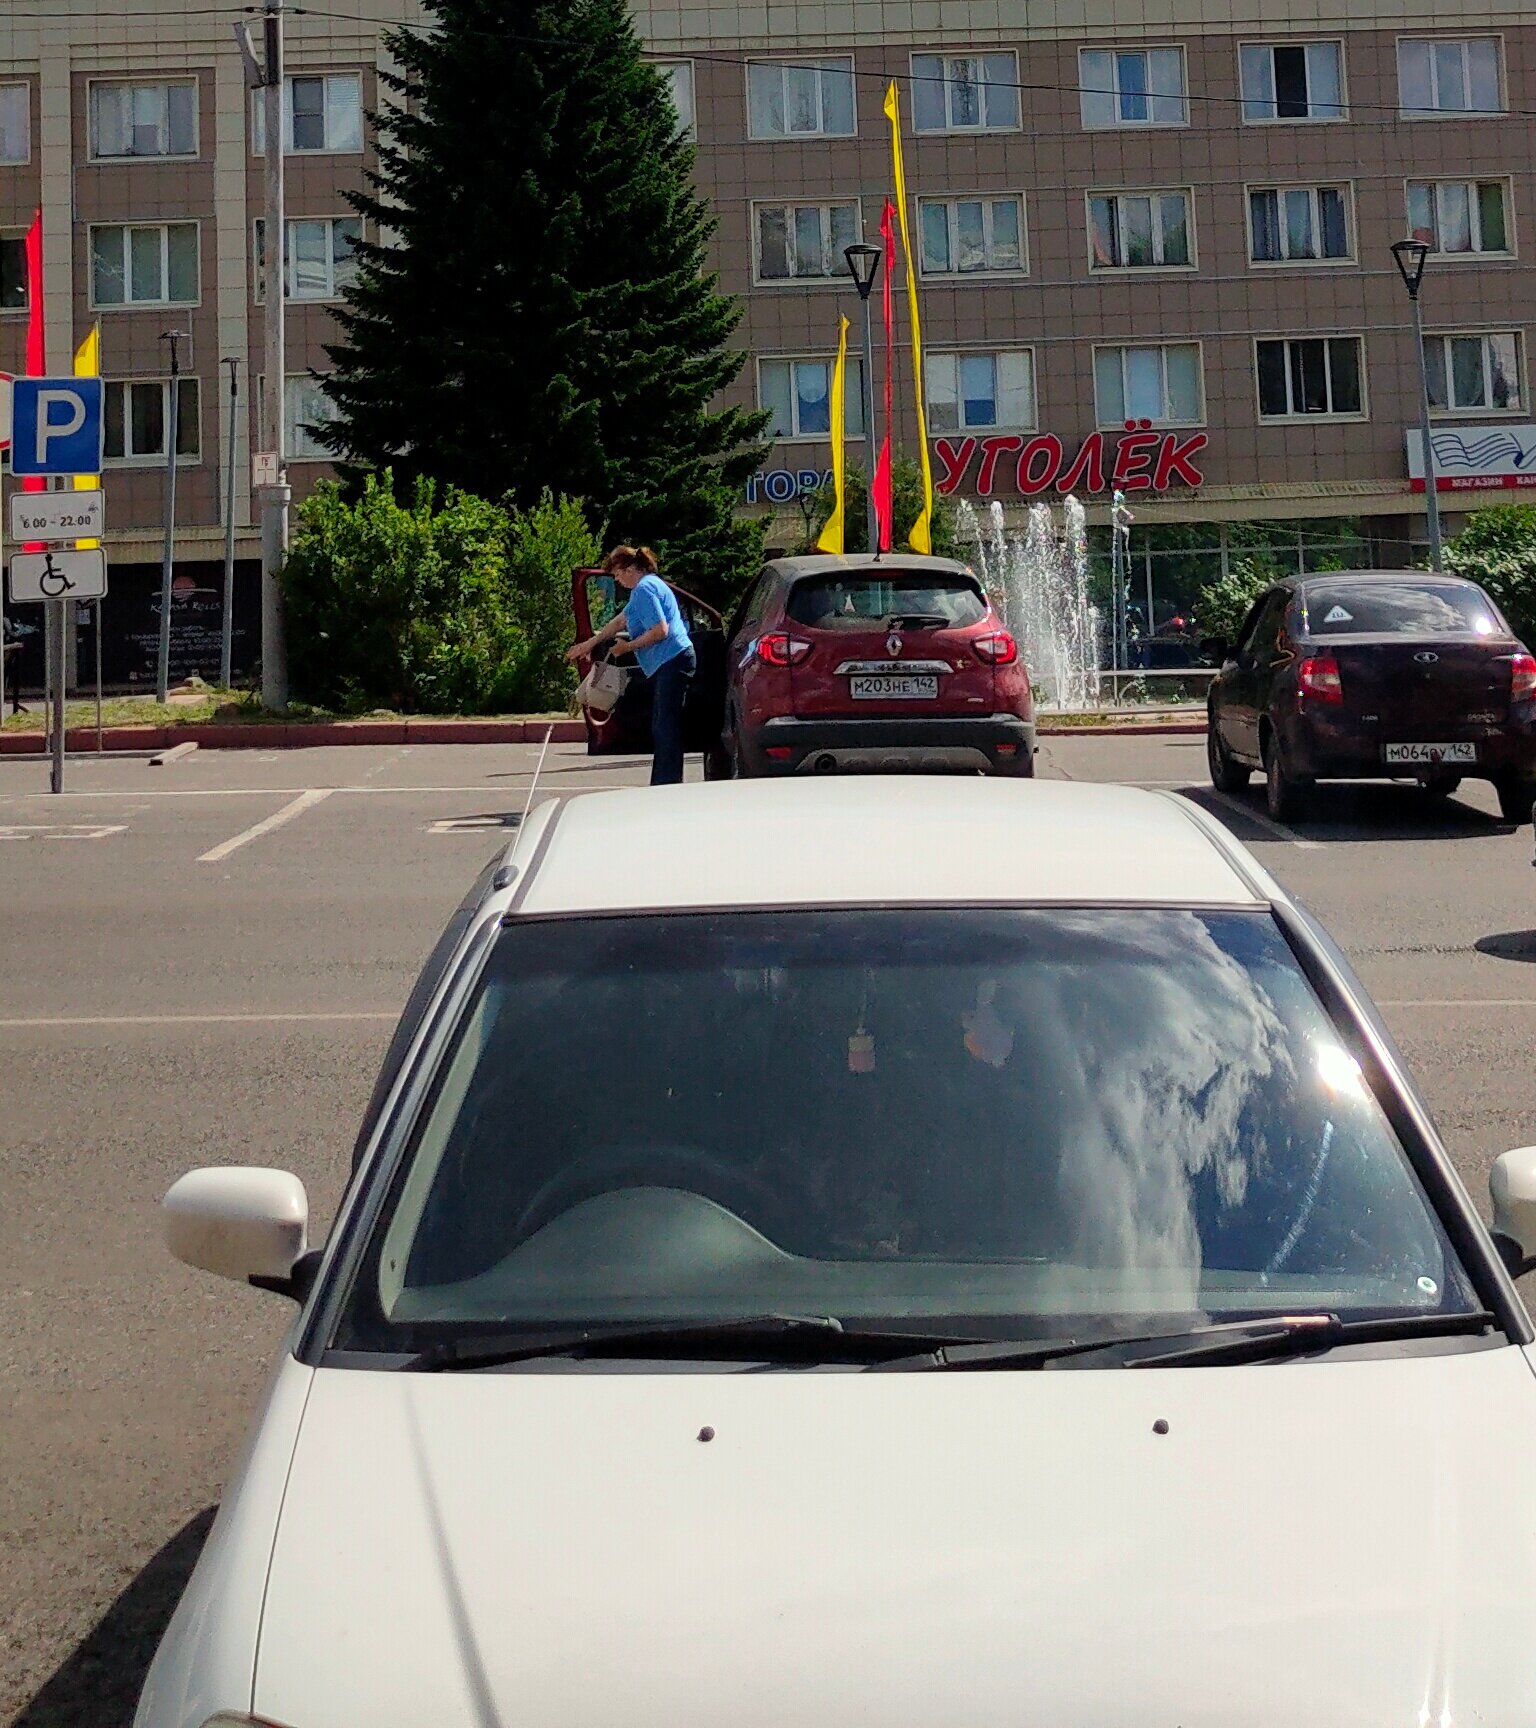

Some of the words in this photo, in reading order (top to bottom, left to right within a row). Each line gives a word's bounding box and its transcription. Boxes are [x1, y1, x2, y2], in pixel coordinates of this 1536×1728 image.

[934, 416, 1209, 496] УГОЛЁК
[1451, 476, 1505, 488] МАГАЗИН
[913, 677, 935, 688] 142
[1450, 743, 1472, 755] 142
